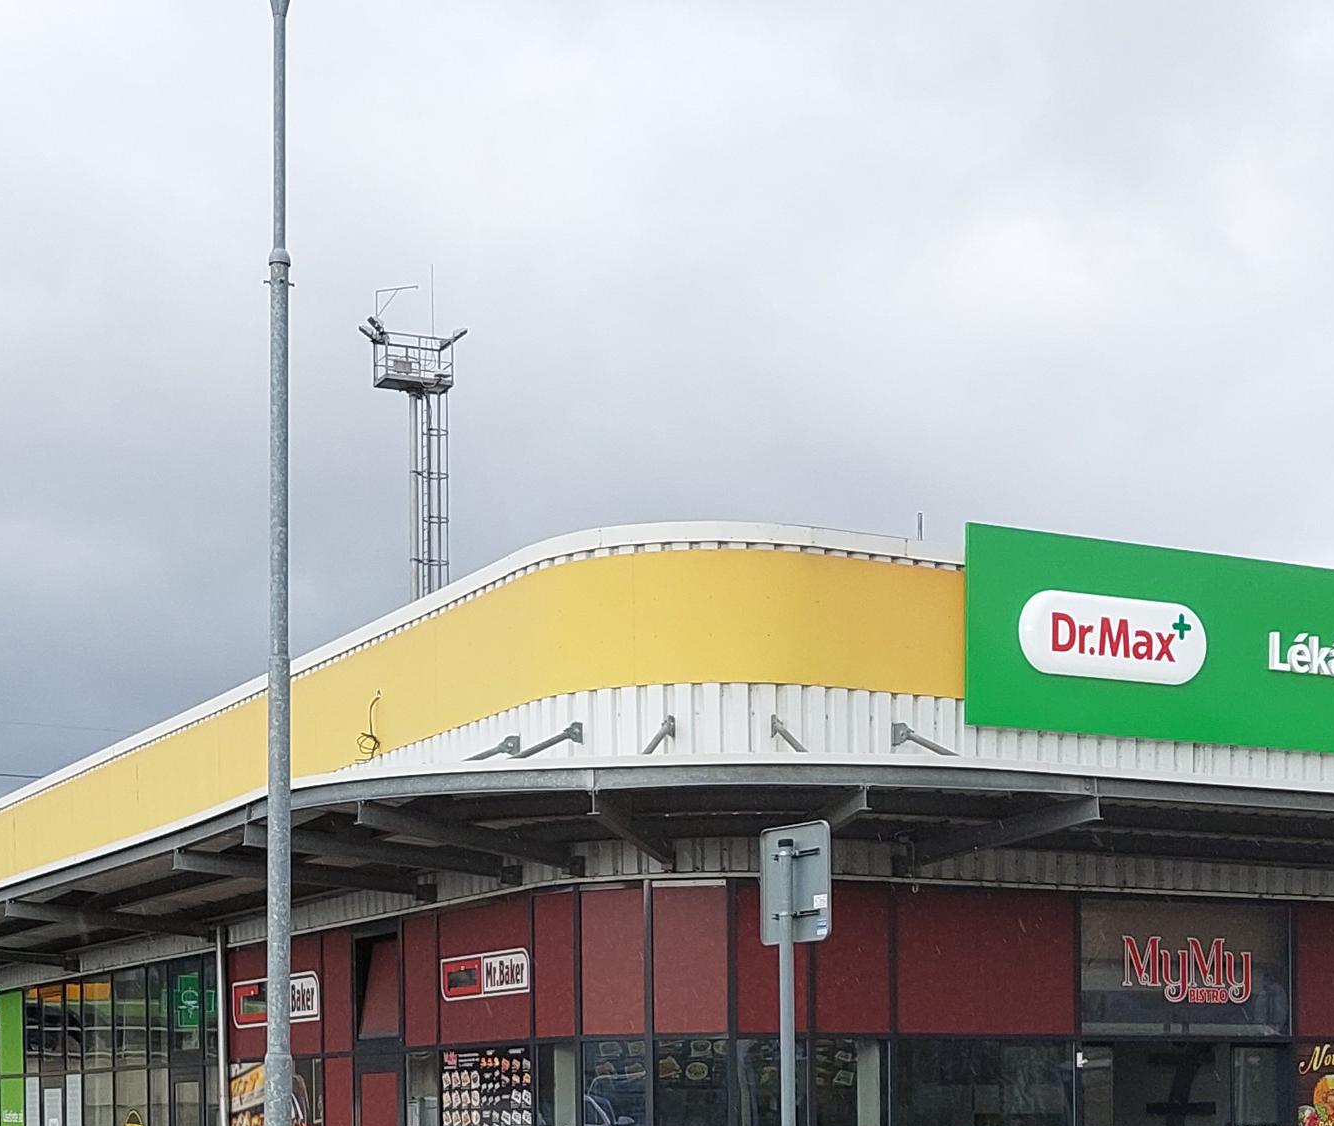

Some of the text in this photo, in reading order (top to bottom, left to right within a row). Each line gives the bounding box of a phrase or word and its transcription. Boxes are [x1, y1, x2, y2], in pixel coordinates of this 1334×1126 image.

[1051, 612, 1176, 663] Dr.Max
[485, 957, 525, 988] Mr.Baker
[1122, 935, 1252, 1004] MyMy
[1188, 988, 1227, 1003] BISTRO
